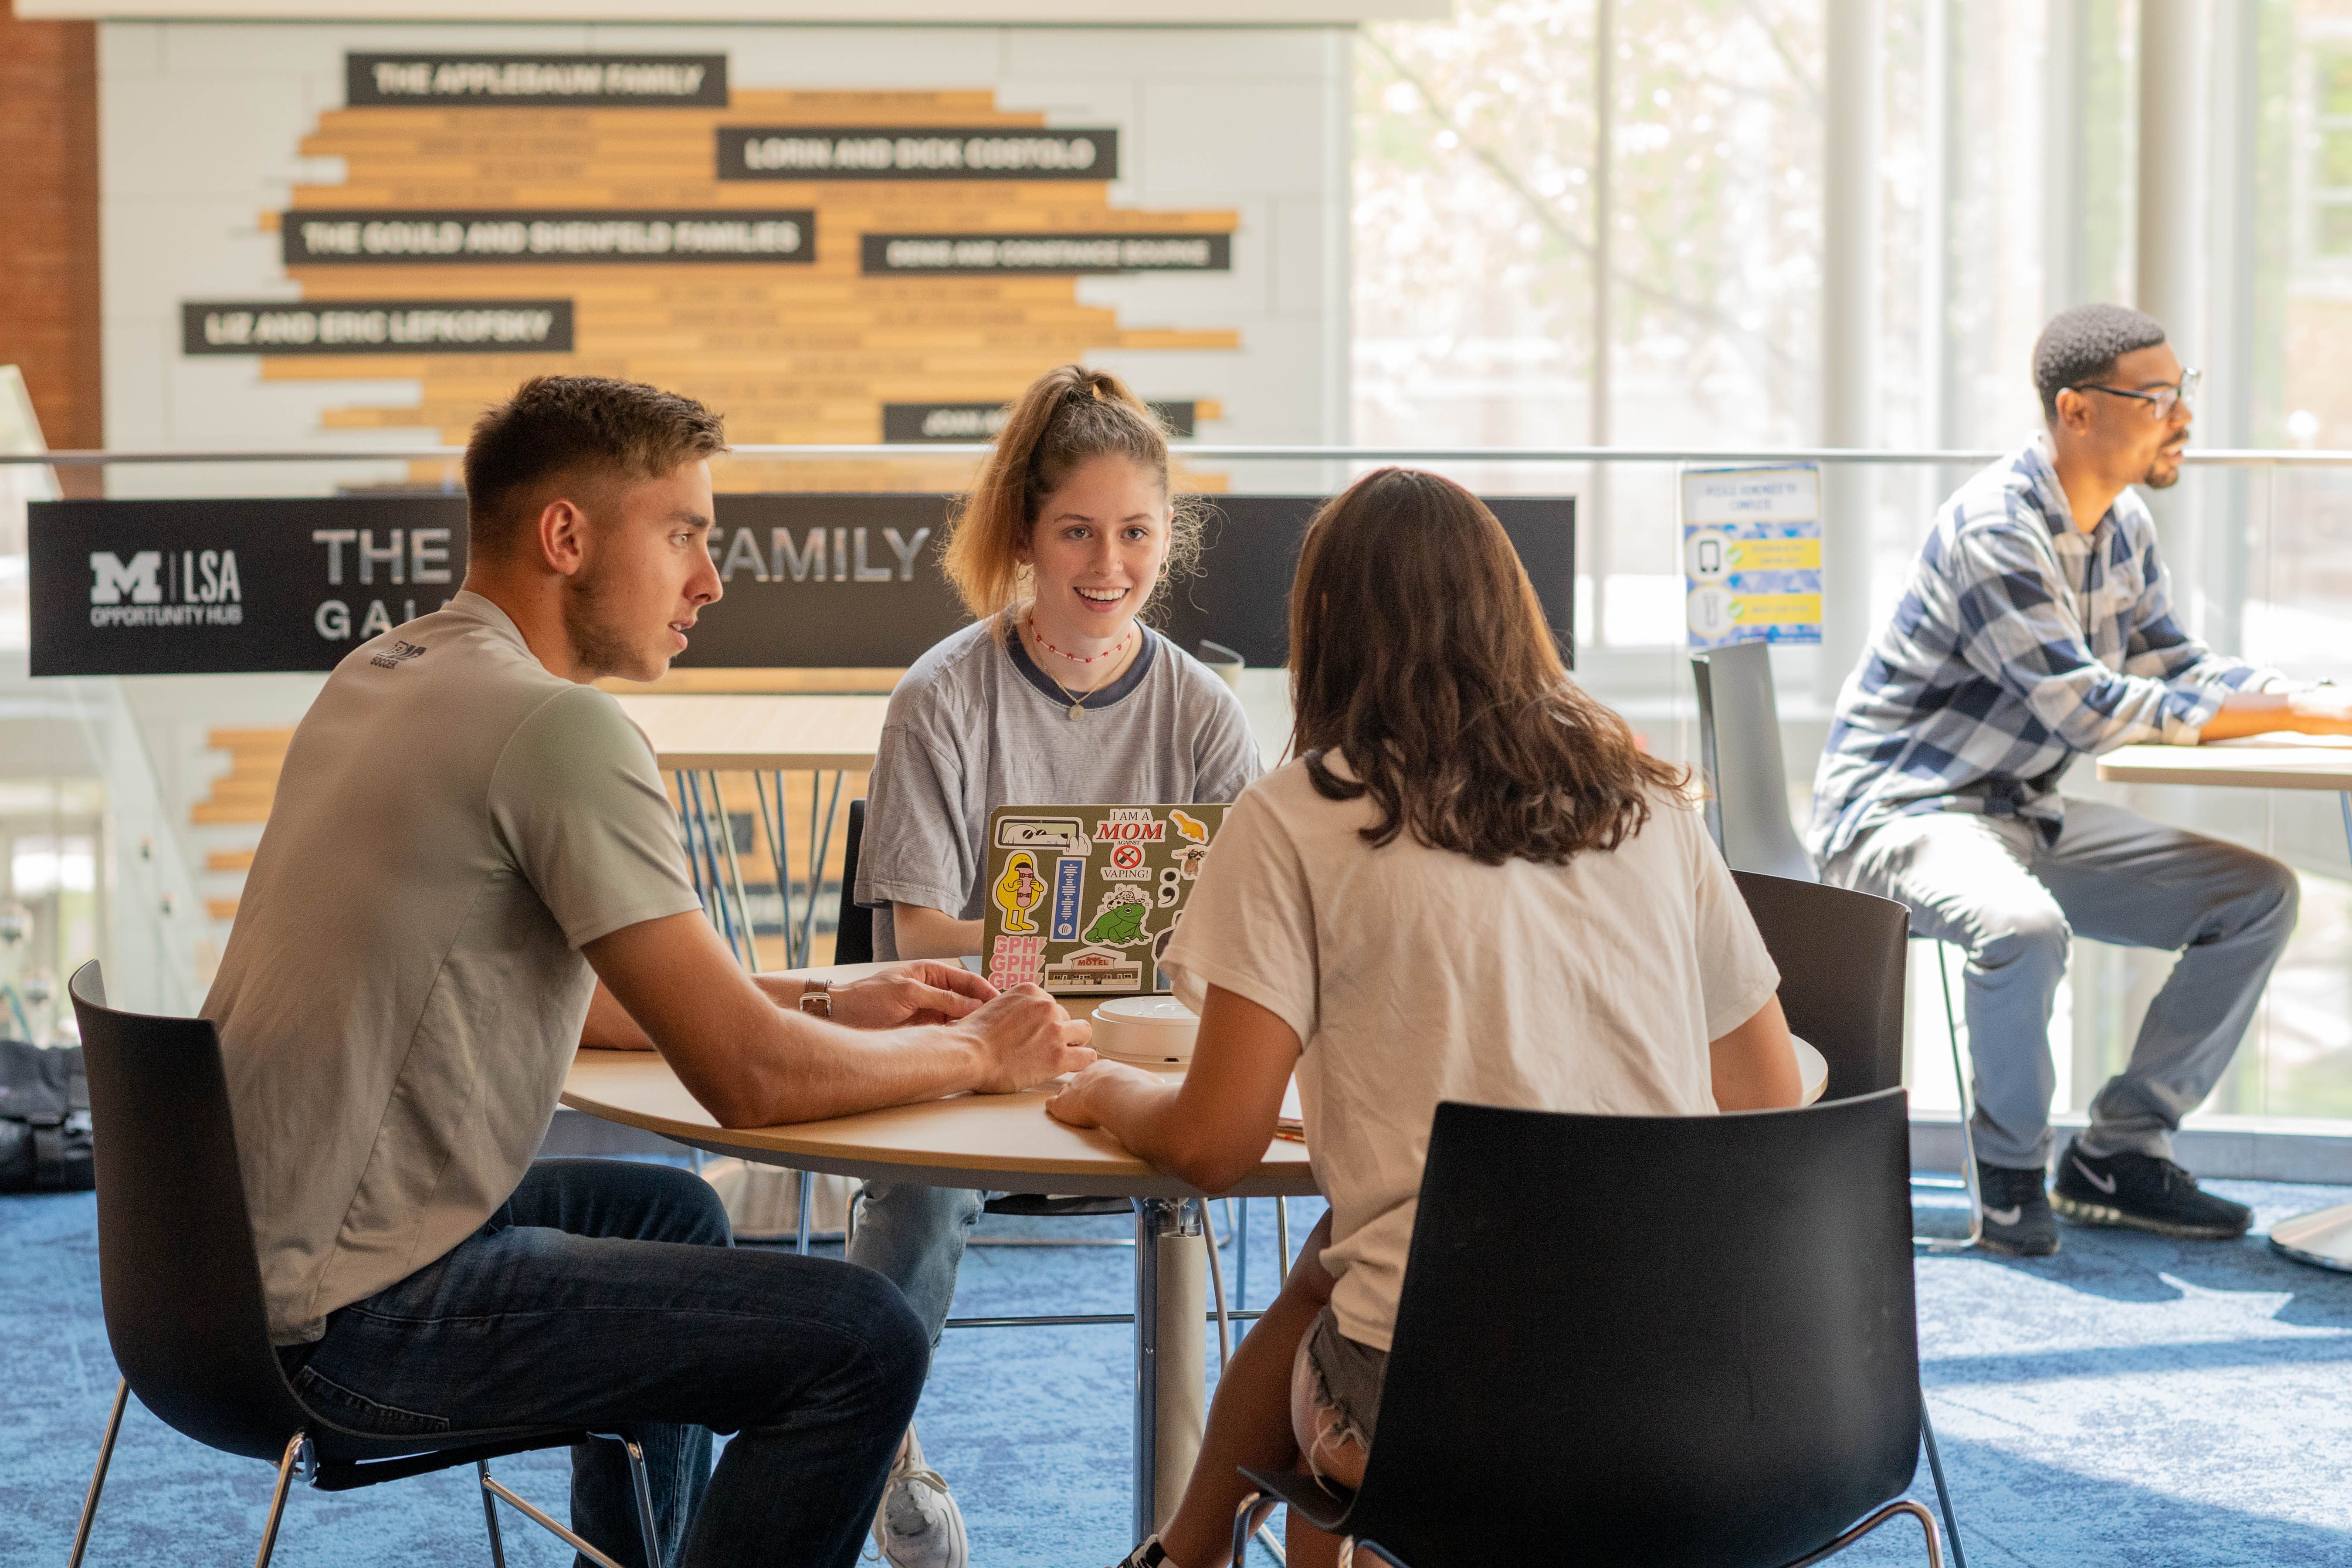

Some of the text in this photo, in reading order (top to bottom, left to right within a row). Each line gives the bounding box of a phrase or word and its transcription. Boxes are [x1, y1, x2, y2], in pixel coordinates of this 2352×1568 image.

[373, 62, 705, 95] THE APPLEBAUM FAMILY
[834, 137, 892, 169] AND
[894, 137, 960, 169] DICK
[301, 221, 360, 254] THE
[362, 221, 464, 254] GOULD
[465, 221, 526, 253] AND
[674, 221, 800, 253] FAMILIES
[251, 312, 318, 344] AND
[319, 311, 388, 344] ERIC
[312, 528, 452, 585] THE
[90, 549, 241, 604] M LSA
[91, 604, 243, 627] OPPORTUNITY HUB
[1095, 823, 1163, 840] MOM
[1112, 812, 1150, 821] I AM A
[1104, 870, 1149, 878] VAPING!
